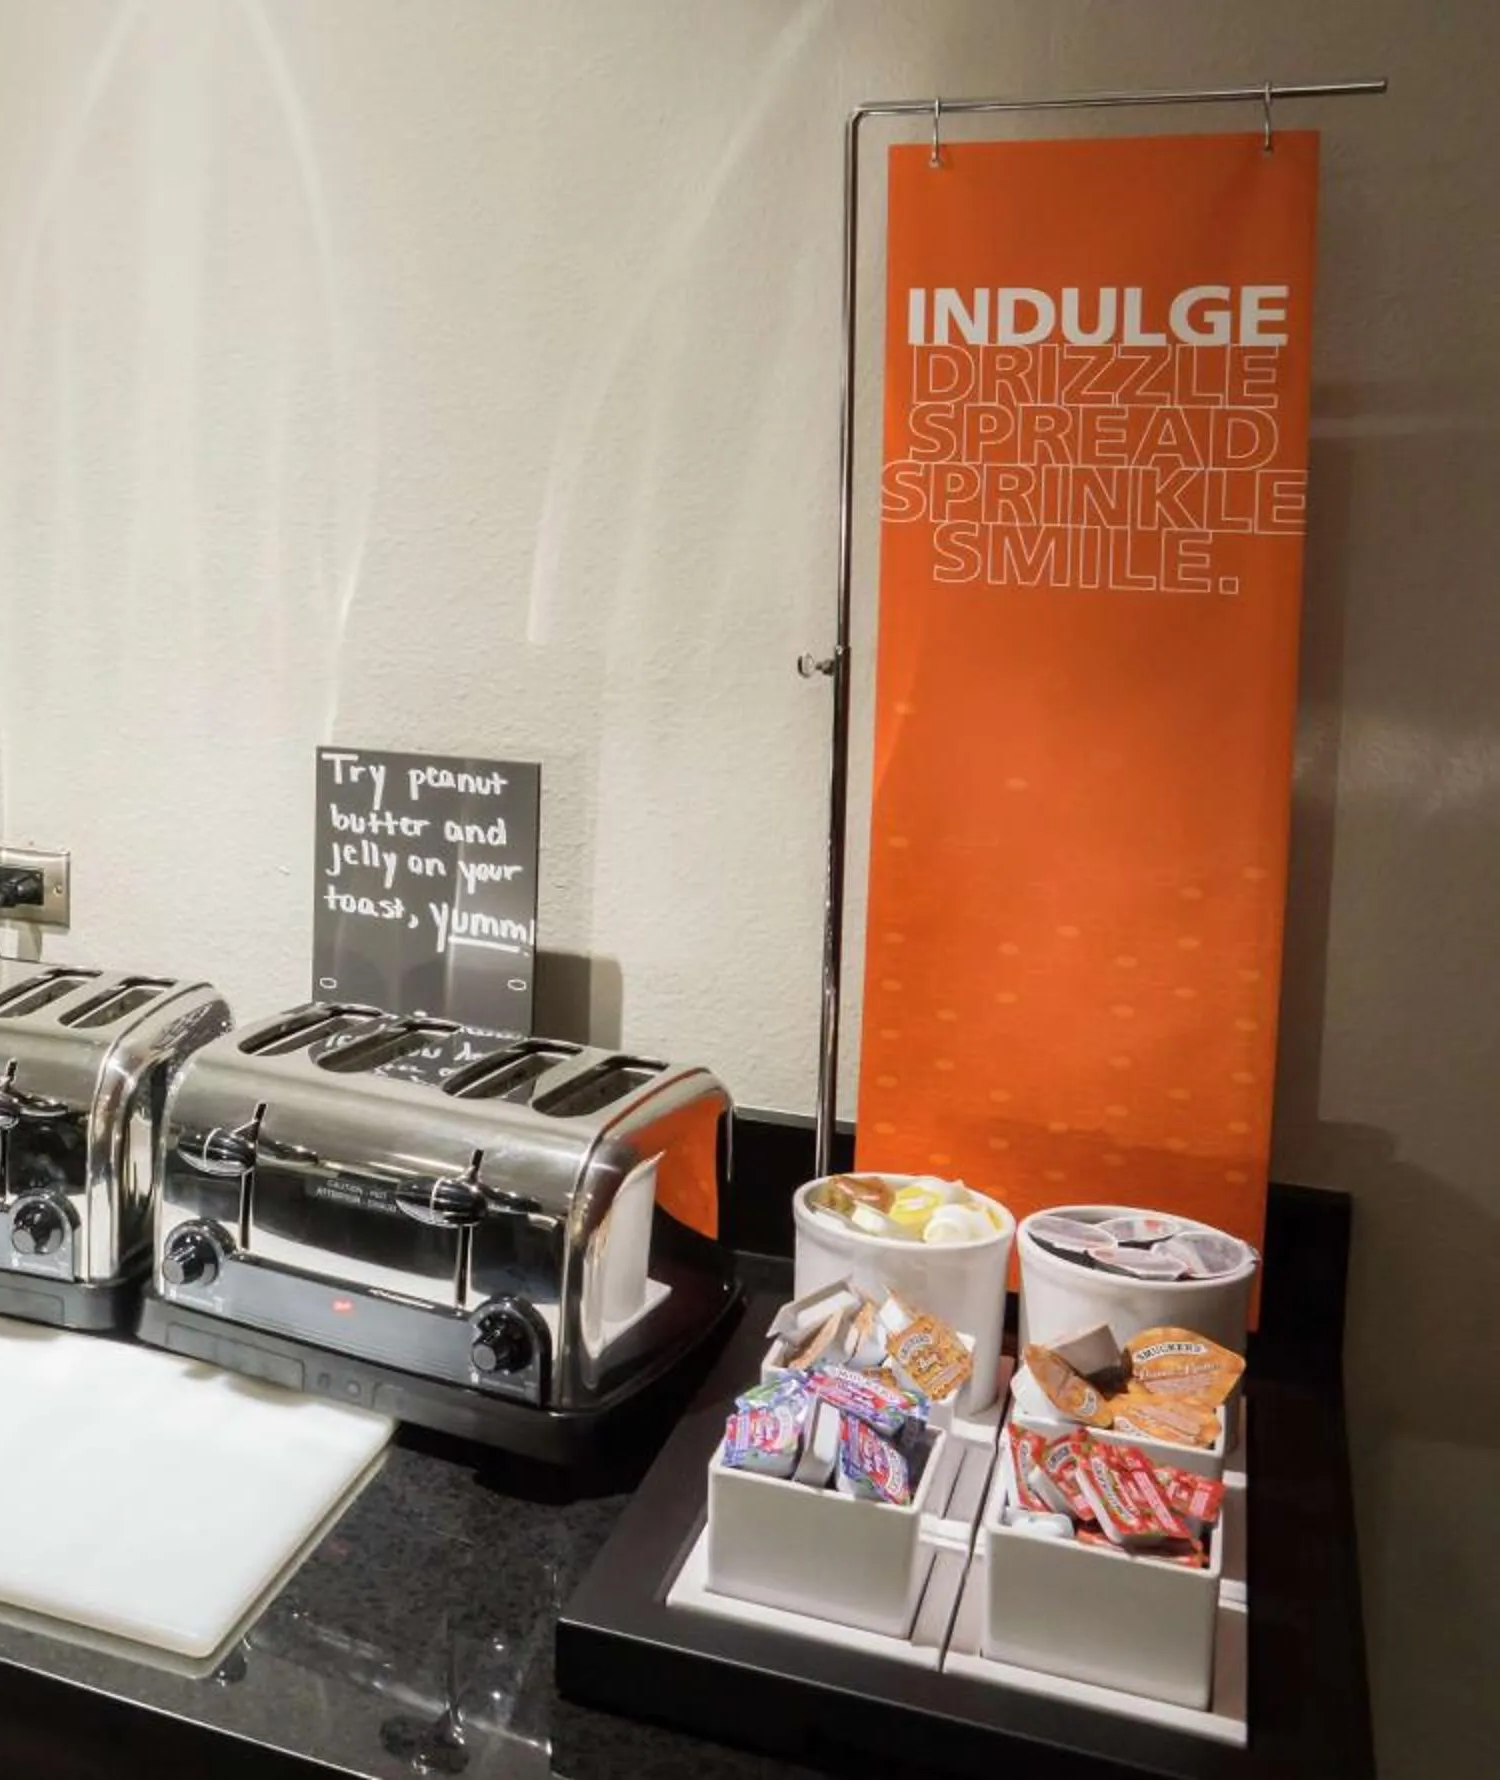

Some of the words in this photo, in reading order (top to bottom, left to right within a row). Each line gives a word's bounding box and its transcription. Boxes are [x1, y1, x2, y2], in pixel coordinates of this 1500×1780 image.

[907, 285, 1289, 346] INDULGE
[912, 343, 1279, 408] DRIZZLE
[908, 402, 1279, 470] SPREAD
[880, 460, 1308, 535] SPRINKLE
[932, 520, 1239, 595] SMILE.
[320, 753, 385, 810] Try
[407, 766, 509, 800] peanut
[329, 803, 431, 837] butter
[443, 817, 507, 845] and
[325, 839, 397, 889] jelly
[407, 854, 447, 877] on
[457, 859, 523, 895] your
[322, 884, 419, 928] toast,
